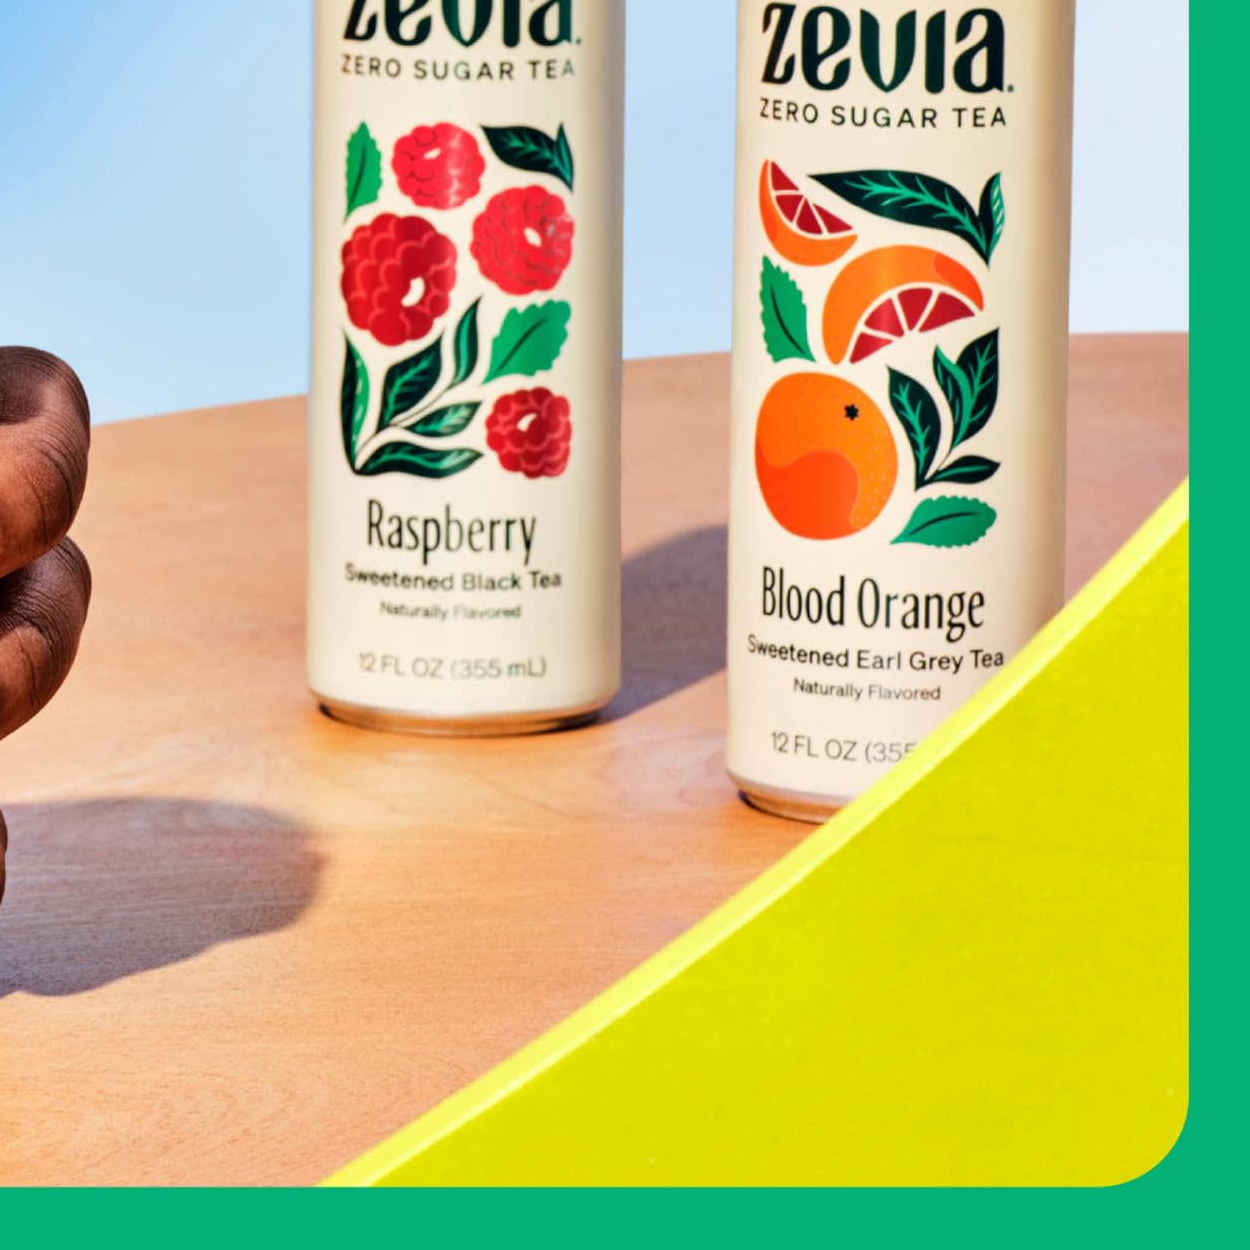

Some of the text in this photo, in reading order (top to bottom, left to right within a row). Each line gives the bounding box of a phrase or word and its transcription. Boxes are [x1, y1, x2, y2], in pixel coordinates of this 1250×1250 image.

[341, 54, 575, 81] ZERO SUGAR TEA
[760, 98, 1007, 129] ZERO SUGAR TEA
[367, 499, 537, 566] Raspberry
[345, 563, 562, 591] Sweetened Black Tea
[379, 601, 521, 621] Naturally Flavored
[762, 566, 985, 643] Blood Orange
[358, 652, 547, 680] 12 FL OZ (355 mL)
[748, 634, 1004, 675] Sweetened Earl Grey Tea
[793, 678, 941, 700] Naturally Flavored
[771, 732, 789, 754] 12
[794, 735, 818, 758] FL
[825, 739, 858, 762] OZ
